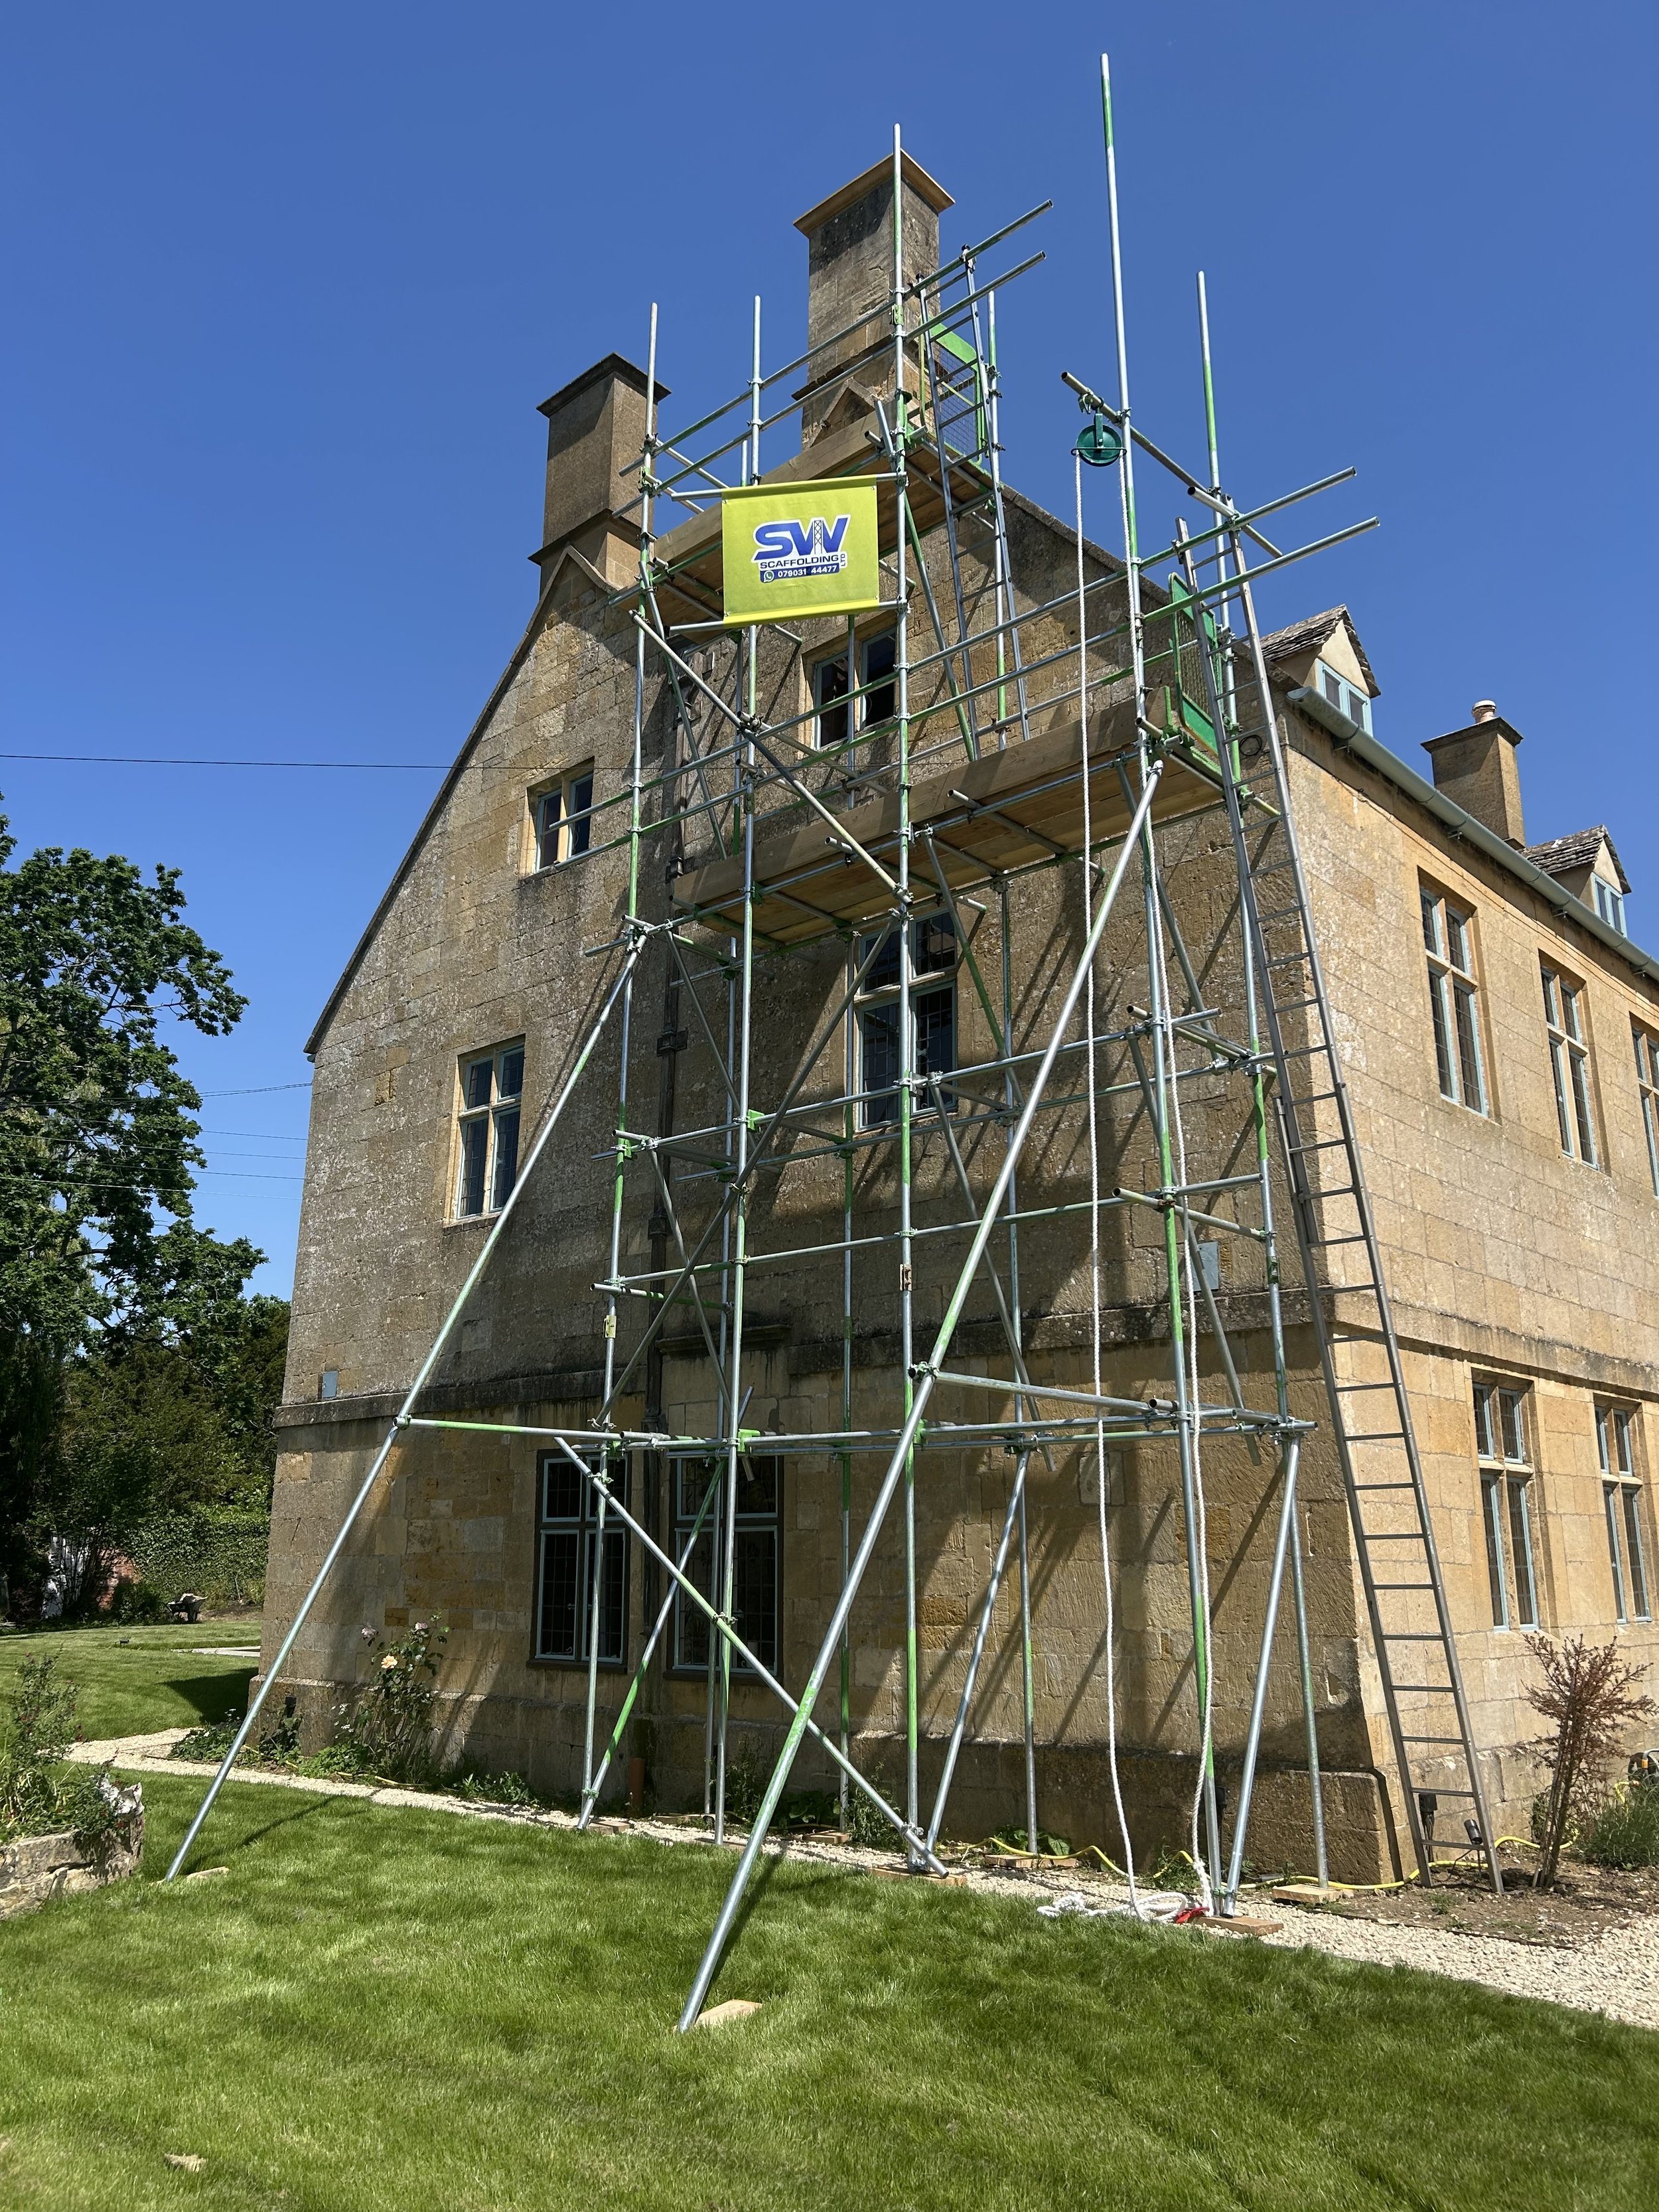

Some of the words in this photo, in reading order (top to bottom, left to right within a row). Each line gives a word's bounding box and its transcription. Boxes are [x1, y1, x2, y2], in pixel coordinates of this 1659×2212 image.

[755, 518, 848, 560] SW
[760, 555, 839, 569] SCAFFOLDING
[778, 569, 806, 577] 079031
[811, 565, 837, 574] 44477
